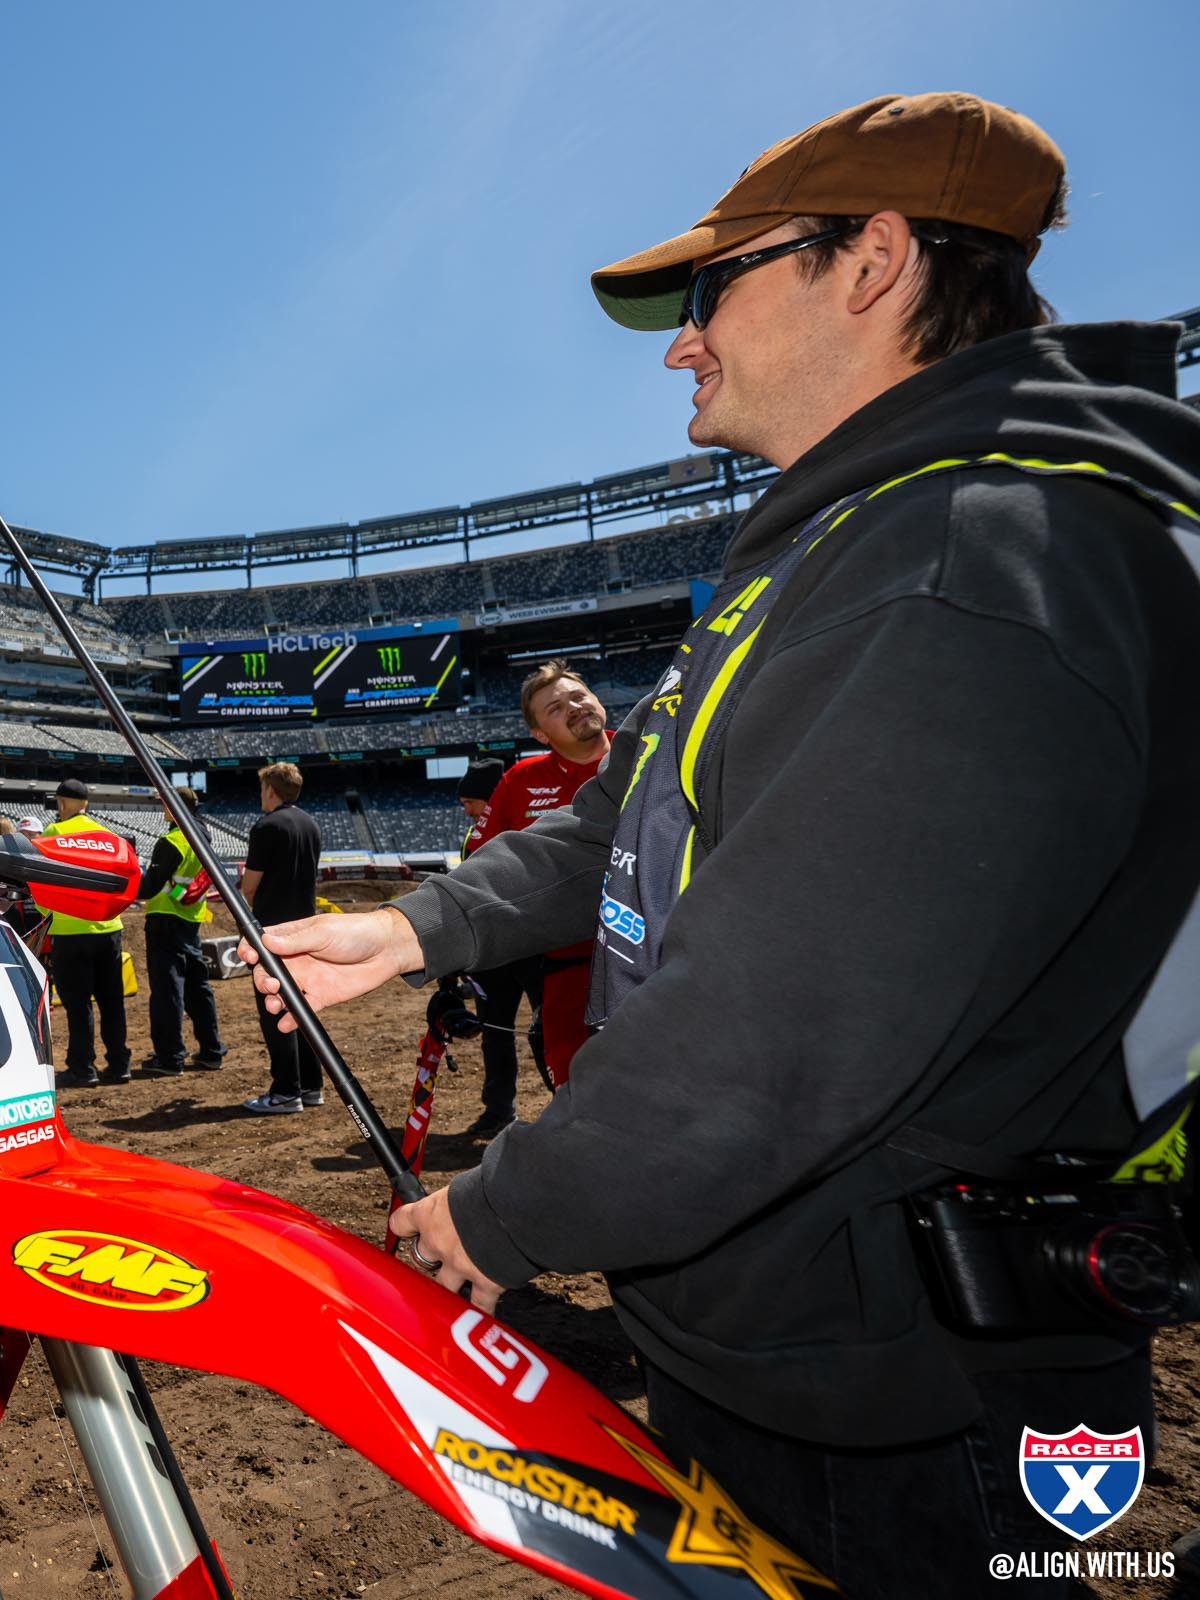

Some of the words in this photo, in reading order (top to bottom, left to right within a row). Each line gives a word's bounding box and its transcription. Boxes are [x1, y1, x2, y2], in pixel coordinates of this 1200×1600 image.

[267, 631, 358, 654] HCLTech
[226, 680, 284, 690] MONSTER
[367, 674, 416, 685] MONSTER
[220, 707, 290, 716] CHAMPIONSHIP
[365, 697, 421, 708] CHAMPIONSHIP
[56, 836, 116, 854] GASGAS
[346, 1103, 372, 1140] Insta360
[13, 1236, 208, 1297] FMF
[434, 1427, 638, 1536] ROCKSTAR
[448, 1458, 542, 1513] ENERGY
[542, 1502, 618, 1551] DRINK
